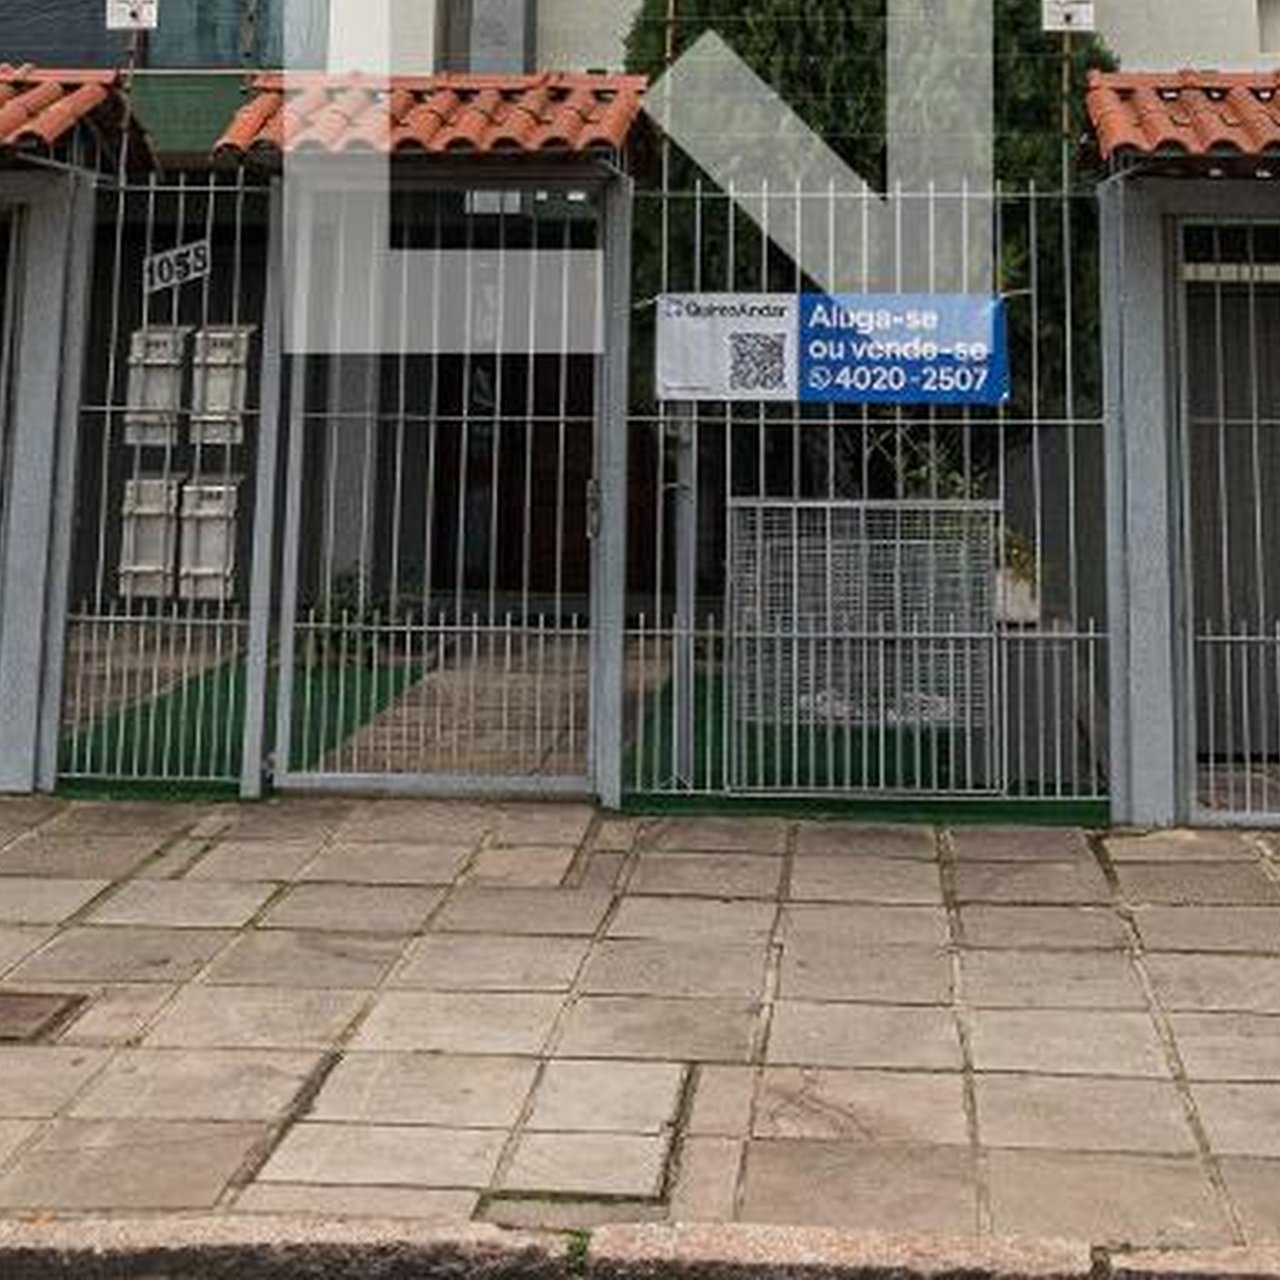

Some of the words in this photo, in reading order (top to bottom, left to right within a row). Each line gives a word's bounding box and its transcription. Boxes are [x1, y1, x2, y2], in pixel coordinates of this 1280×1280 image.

[685, 301, 787, 319] QuintoAndar
[808, 304, 939, 334] Aluga-se
[808, 340, 844, 360] ou
[851, 338, 988, 363] vende-se
